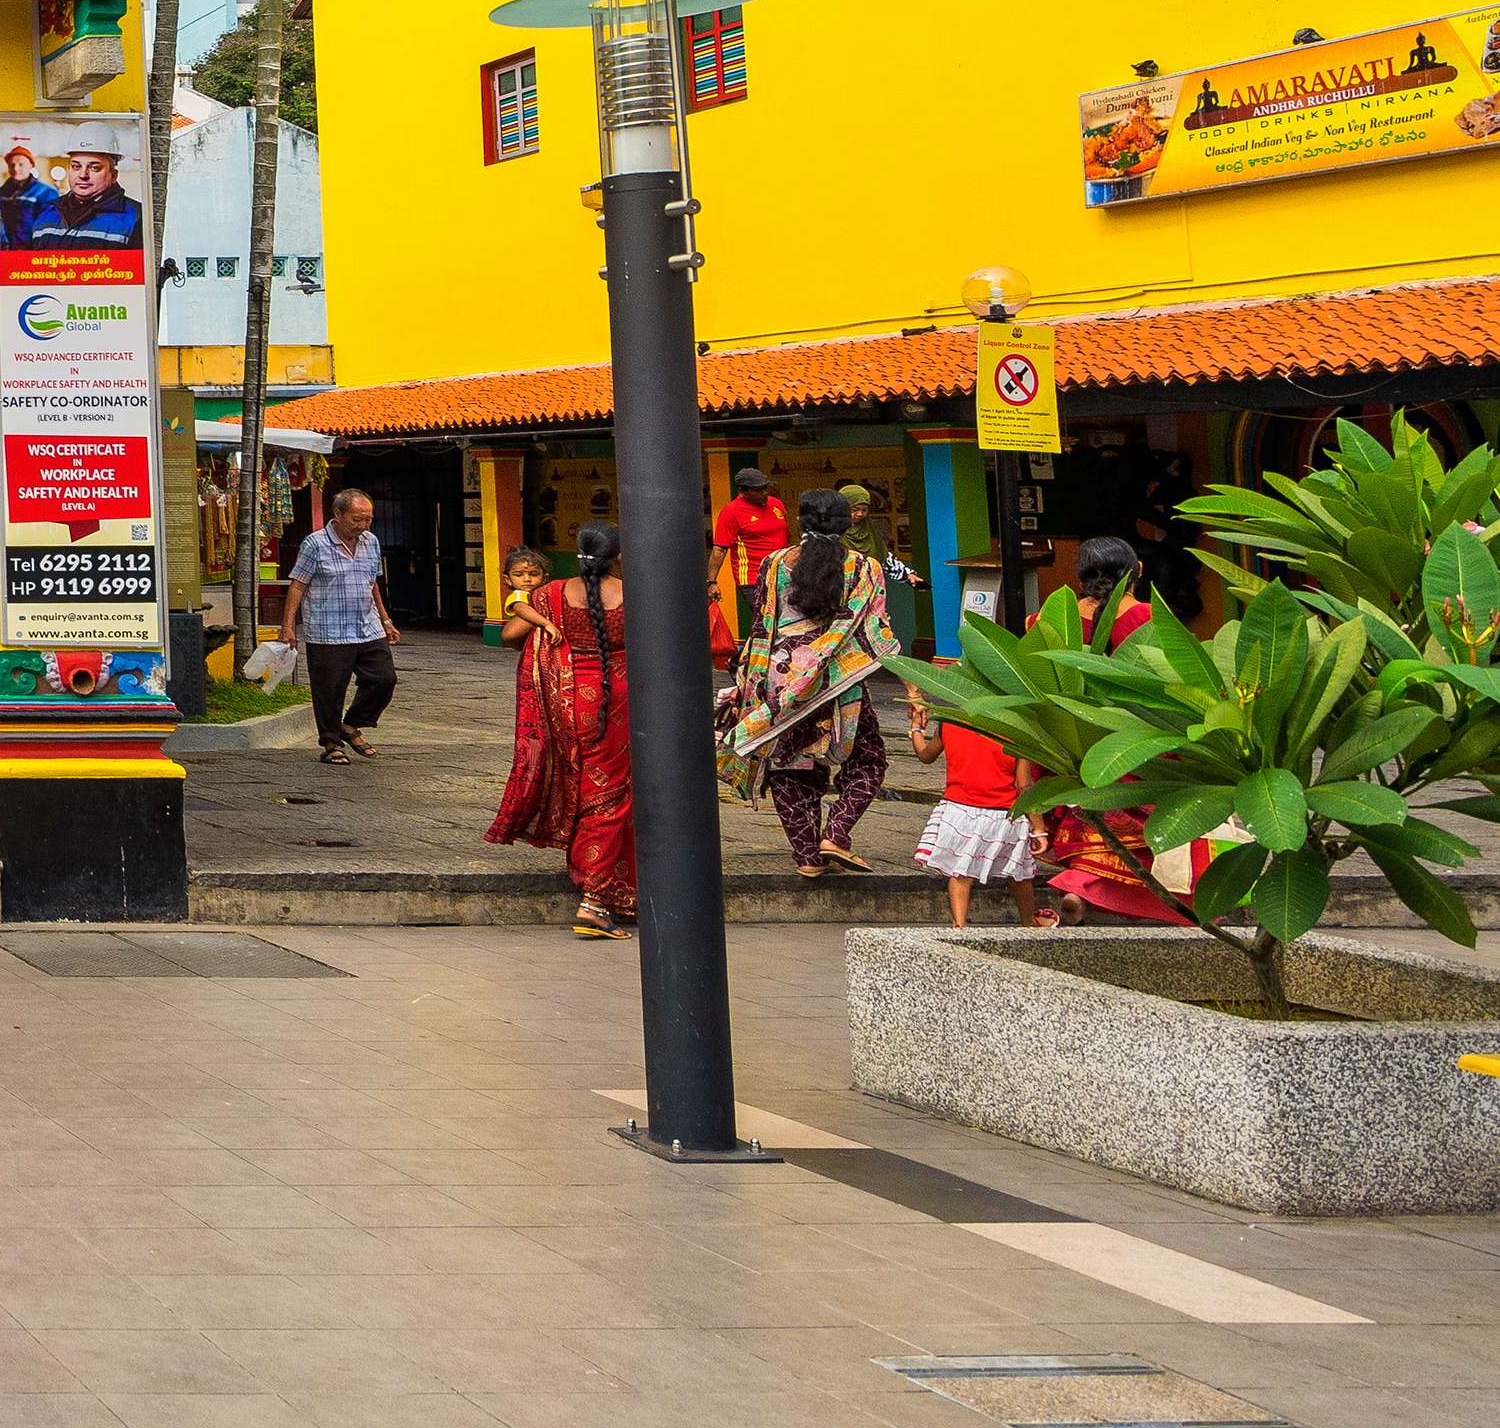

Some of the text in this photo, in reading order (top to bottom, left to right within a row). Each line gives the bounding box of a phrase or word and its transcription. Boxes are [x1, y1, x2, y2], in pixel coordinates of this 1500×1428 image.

[1464, 10, 1500, 25] Authen
[1229, 56, 1396, 109] AMARAVATI
[1135, 85, 1166, 97] Chicken
[1105, 101, 1132, 114] Dum
[1253, 85, 1376, 118] ANDHRA RUCHULLU
[1188, 86, 1455, 142] FOOD DRINKS NIRVANA
[1205, 108, 1434, 158] Classical Indian Veg Non Veg Restaurant
[66, 303, 128, 320] Avanta
[66, 322, 102, 332] Global
[983, 340, 1005, 348] Liquor
[1006, 341, 1032, 349] Control
[2, 395, 149, 408] SAFETY CO-ORDINATOR
[28, 443, 127, 458] WSQ CERTIFICATE
[40, 468, 116, 481] WORKPLACE
[18, 486, 139, 500] SAFETY AND HEALTH
[10, 553, 152, 572] Tel 6295 2112
[11, 577, 152, 596] HP 9119 6999
[30, 612, 145, 624] enquiry@avanta.com.sg
[28, 628, 149, 641] www.avanta.com.sg
